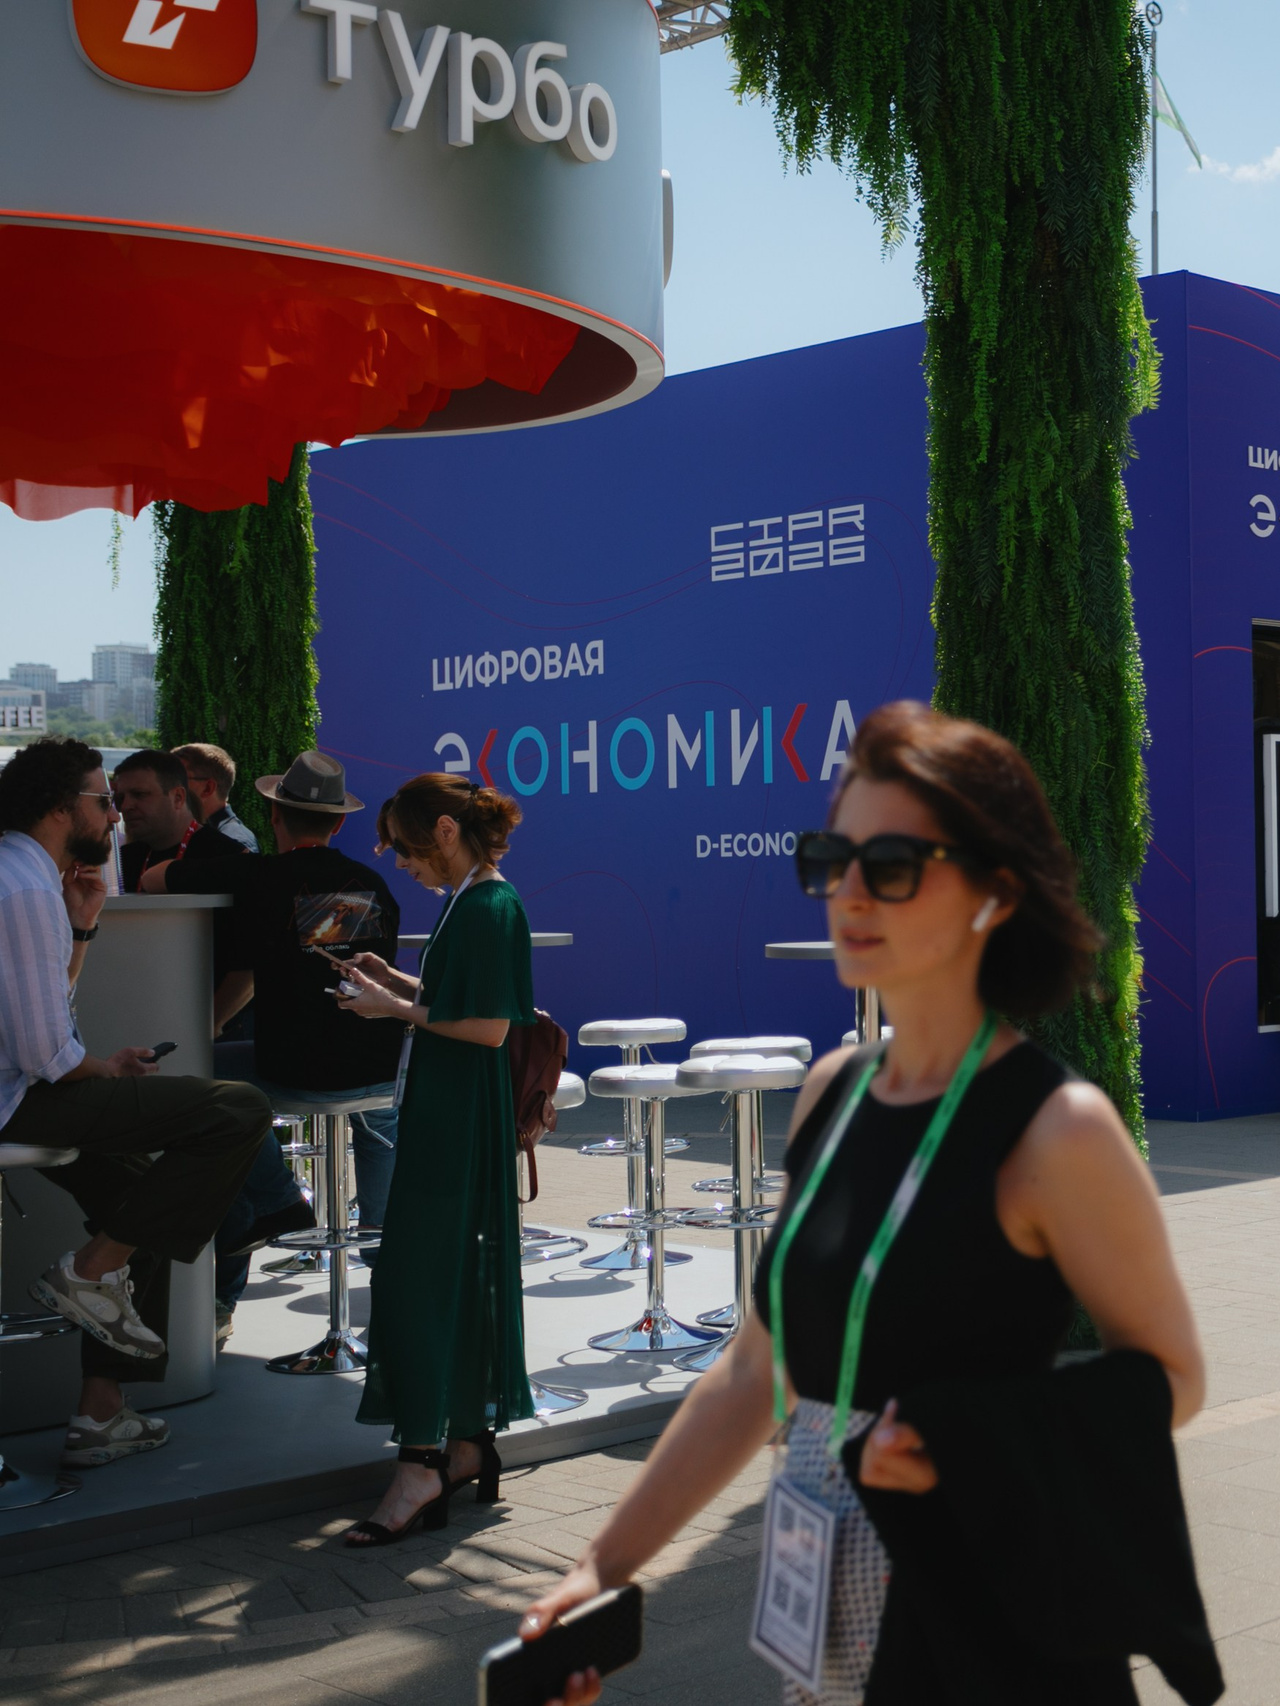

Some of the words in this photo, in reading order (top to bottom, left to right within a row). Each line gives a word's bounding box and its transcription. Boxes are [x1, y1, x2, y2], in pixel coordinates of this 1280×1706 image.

[711, 503, 865, 552] CIPR
[711, 534, 865, 582] 2026
[432, 639, 605, 692] ЦИФРОВАЯ
[0, 706, 44, 728] FEE
[696, 831, 816, 858] D-ECONO
